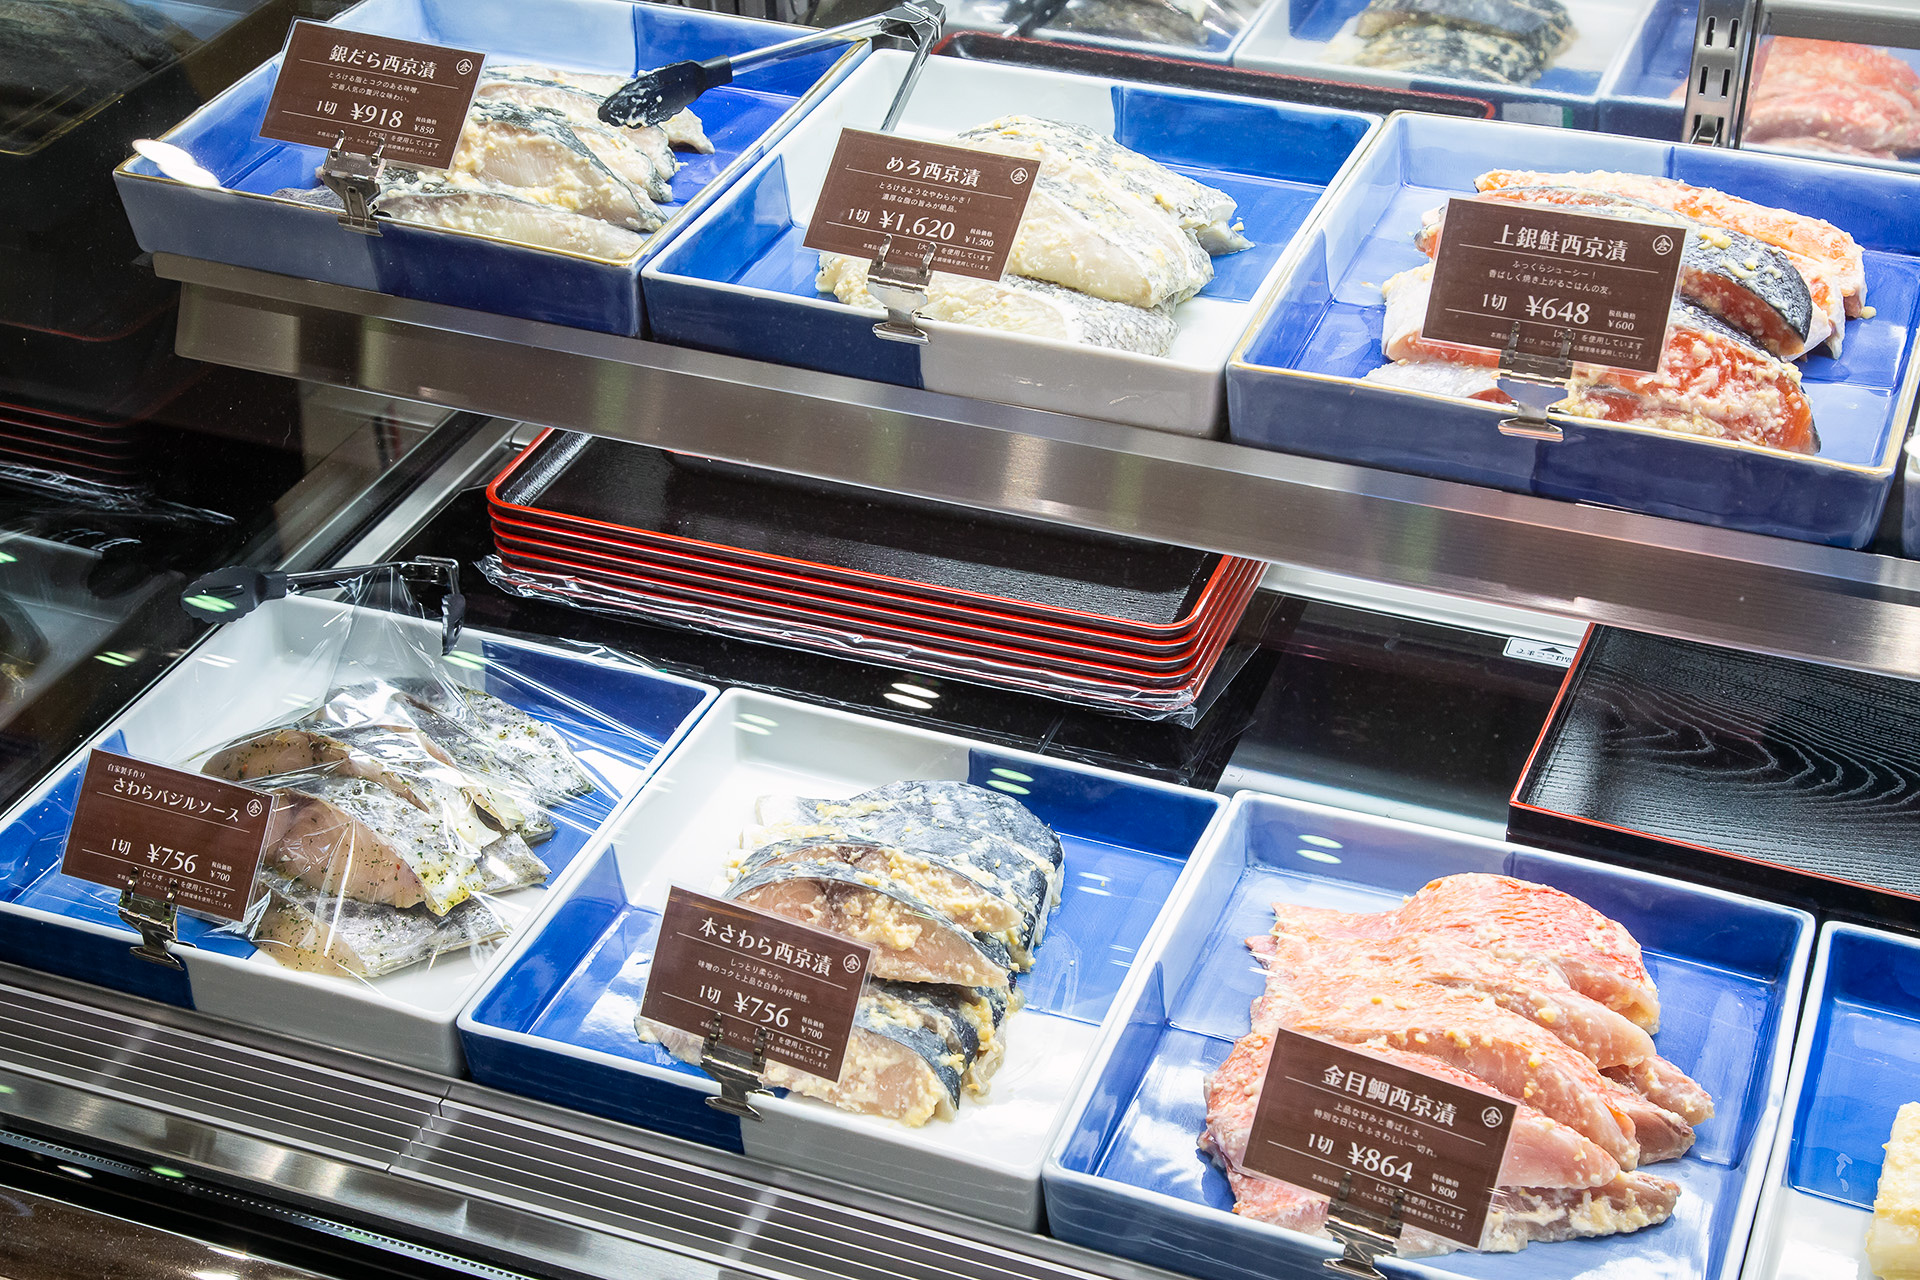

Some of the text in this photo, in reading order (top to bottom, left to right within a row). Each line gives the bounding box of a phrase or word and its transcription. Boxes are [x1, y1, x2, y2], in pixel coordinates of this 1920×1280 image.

[328, 44, 437, 79] 銀だら西京漬
[330, 82, 411, 102] 定番人気の贅沢な味わい。
[316, 100, 403, 127] 1切 ¥918
[414, 124, 434, 134] ¥850
[886, 156, 980, 187] めろ西京漬
[878, 181, 970, 203] とろけるようなやわらかさ！
[881, 193, 958, 212] 濃厚な脂の旨みが絶品。
[848, 208, 955, 240] 1切 ¥1,620
[1493, 224, 1627, 262] 上銀鮭西京漬
[1489, 269, 1613, 294] 香ばしく焼き上がるごはんの友。
[1512, 260, 1595, 279] ふっくらジューシー！
[1482, 293, 1590, 324] 1切 ¥648
[1608, 319, 1634, 330] ¥600
[113, 777, 238, 822] さわらバジルソース
[111, 838, 198, 873] 1切 ¥756
[210, 870, 230, 882] ¥700
[698, 917, 832, 976] 本さわら西京漬
[697, 959, 811, 1003] 味噌のコクと上品な白身が好相性。
[730, 958, 785, 982] しっとり柔らか。
[699, 985, 791, 1027] 1切 ¥756
[801, 1025, 822, 1039] ¥700
[1321, 1064, 1456, 1126] 金目鯛西京漬
[1313, 1108, 1438, 1157] 特別な日にもふさわしい一切れ。
[1333, 1102, 1425, 1139] 上品な甘みと香ばしさ。
[1308, 1133, 1412, 1182] 1切 ¥864
[1431, 1182, 1456, 1199] ¥800
